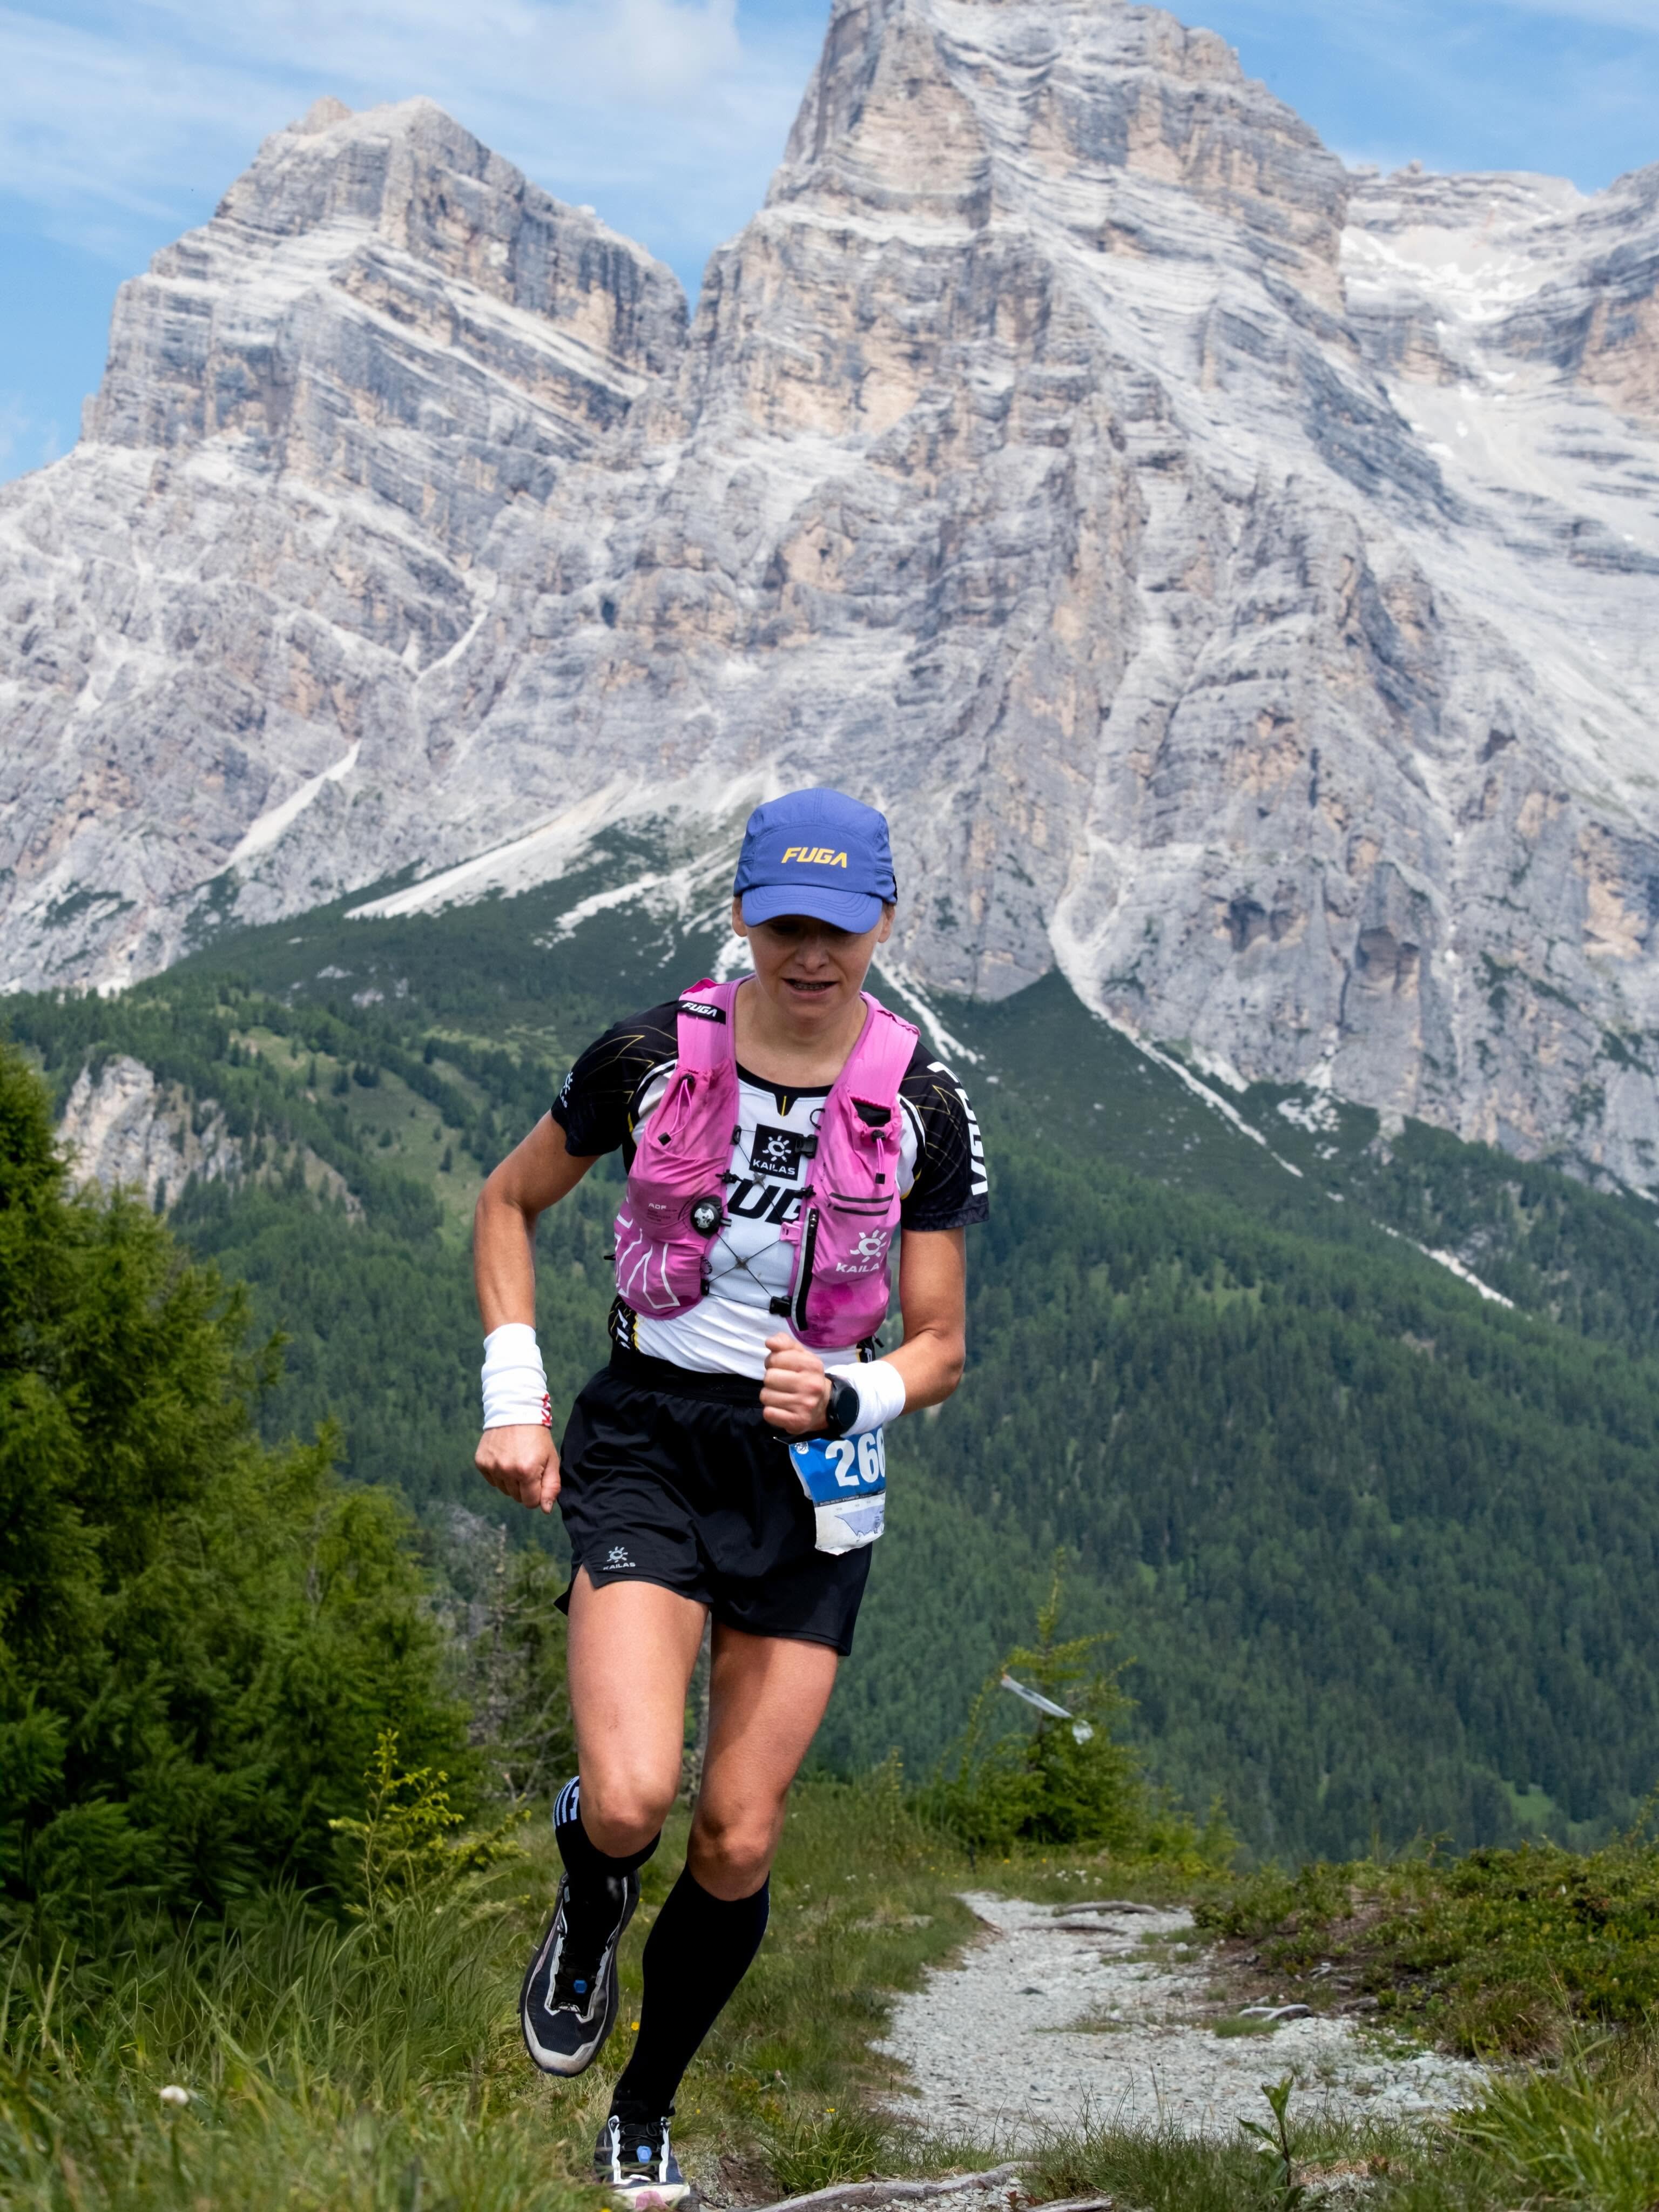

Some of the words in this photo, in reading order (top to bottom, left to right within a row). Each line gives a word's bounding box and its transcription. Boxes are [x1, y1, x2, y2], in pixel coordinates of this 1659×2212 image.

[781, 847, 847, 868] FUGA
[682, 1002, 718, 1017] FUGA
[753, 1159, 795, 1176] KAILAS
[727, 1178, 802, 1225] UG
[835, 1262, 880, 1273] KAILA
[603, 1562, 636, 1571] KAILAS
